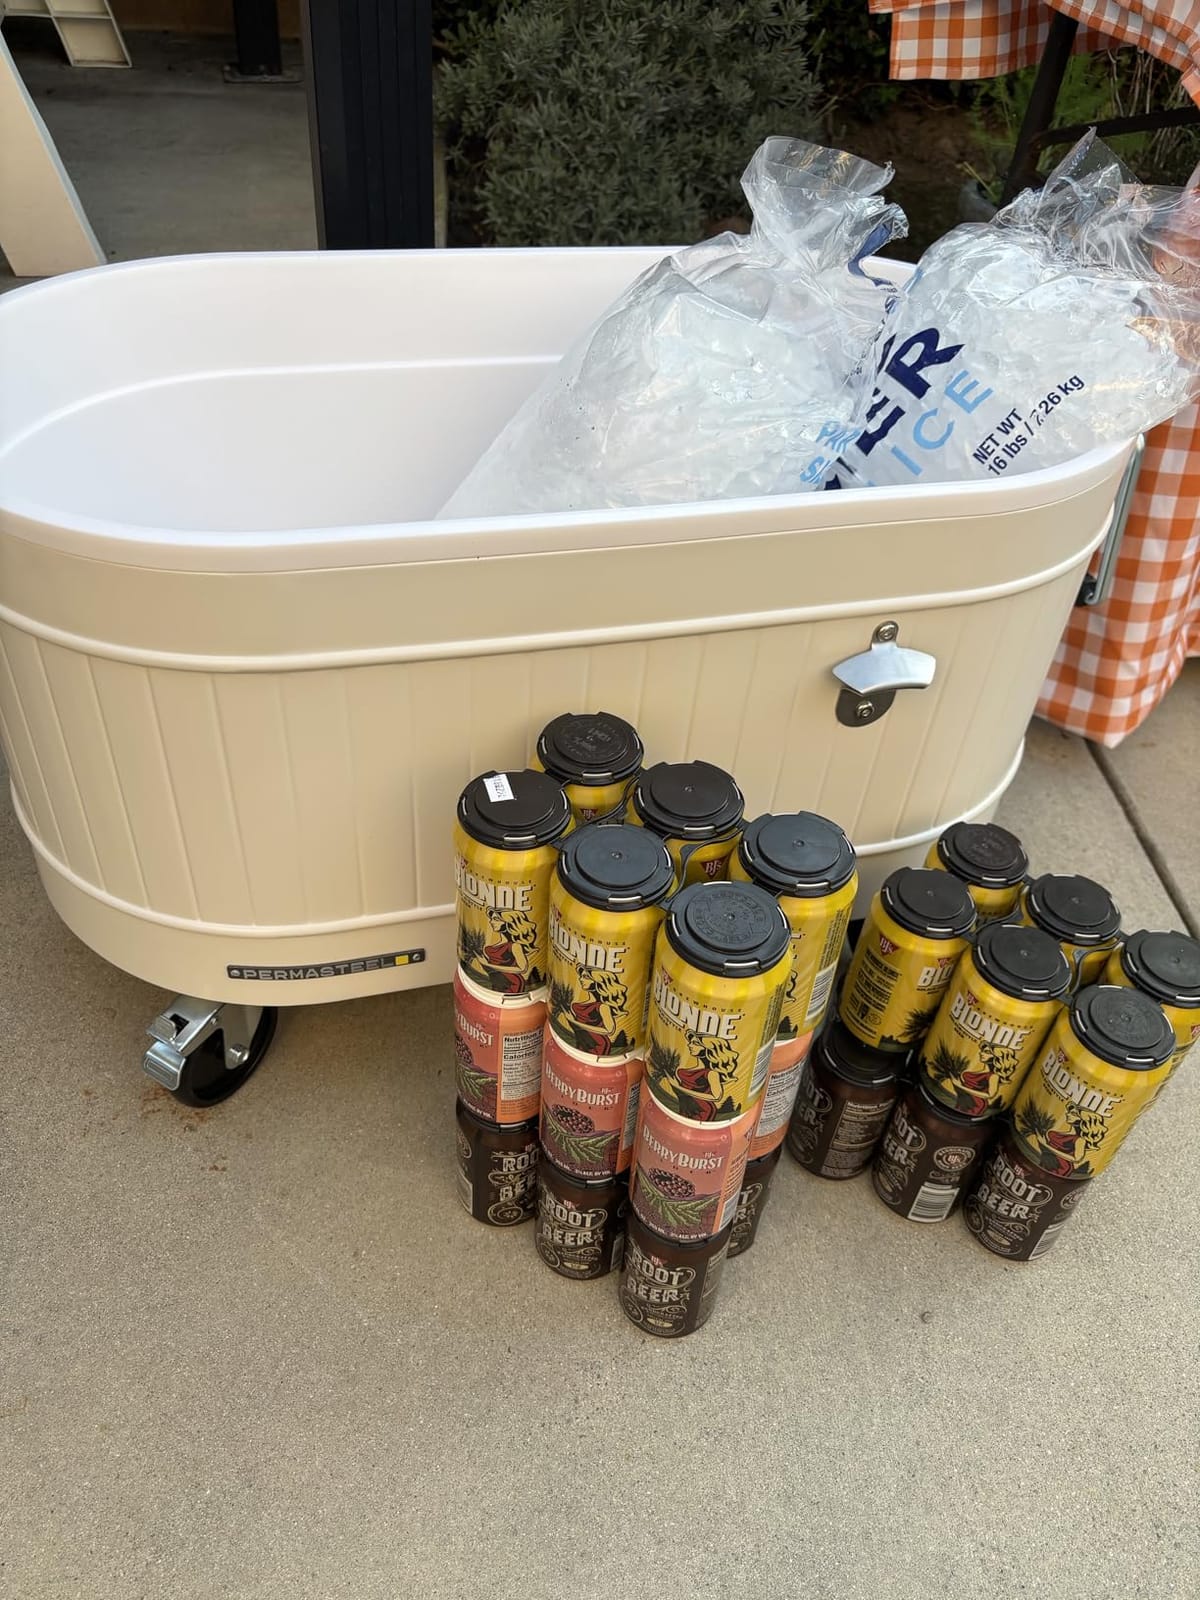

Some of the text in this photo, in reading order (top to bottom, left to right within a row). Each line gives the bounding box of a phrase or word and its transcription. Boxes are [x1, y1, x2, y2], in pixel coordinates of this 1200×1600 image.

[890, 370, 994, 477] ICE
[972, 408, 1023, 465] NET WT
[988, 456, 1008, 476] 16
[1002, 434, 1028, 459] lbs
[1057, 375, 1085, 396] kg
[243, 957, 394, 980] PERMASTEEL
[950, 991, 1033, 1051] BLONDE
[1041, 1047, 1122, 1119] BLONDE
[993, 1155, 1042, 1203] ROOT
[545, 1193, 597, 1228] ROOT
[977, 1184, 1031, 1220] BEER
[542, 1222, 594, 1246] BEER
[632, 1247, 684, 1286] ROOT
[627, 1275, 679, 1303] BEER
